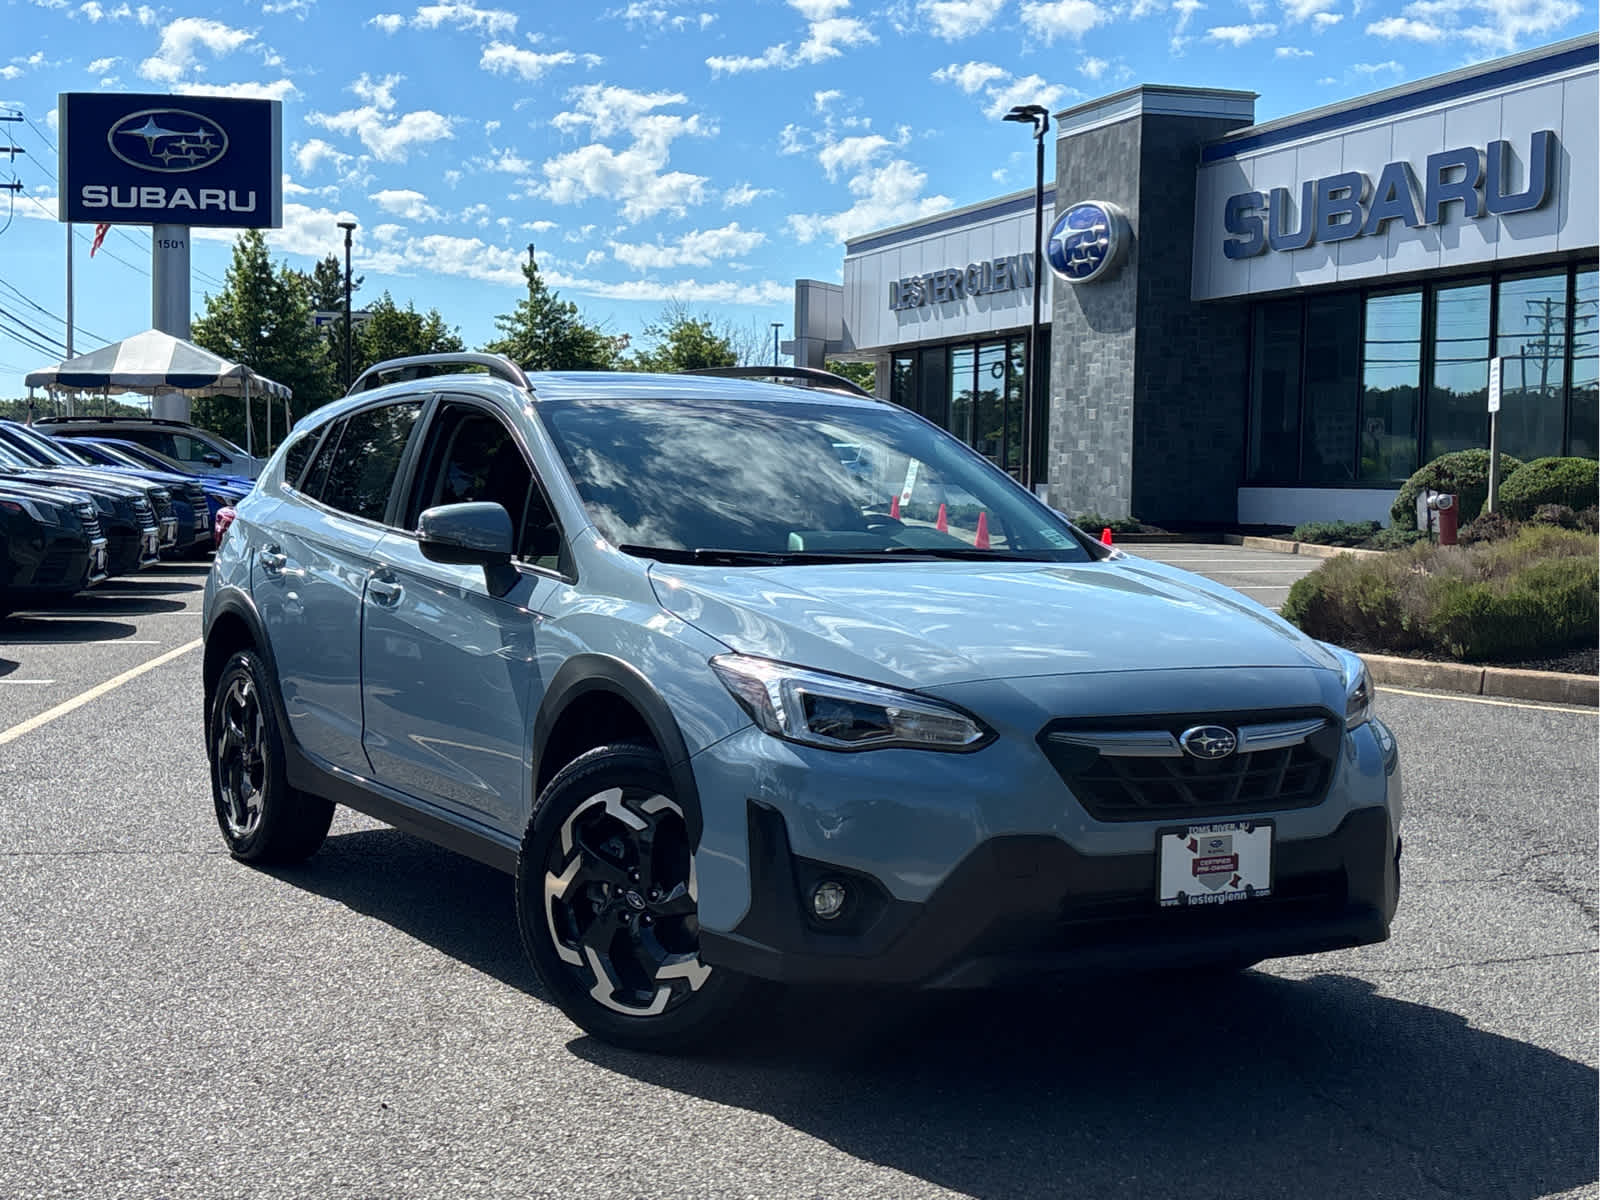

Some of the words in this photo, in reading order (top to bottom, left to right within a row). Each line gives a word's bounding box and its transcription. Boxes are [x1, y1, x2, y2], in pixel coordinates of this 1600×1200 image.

[82, 184, 256, 213] SUBARU
[1223, 130, 1554, 260] SUBARU
[157, 239, 185, 249] 1501
[889, 267, 963, 310] LESTER
[1187, 890, 1247, 905] lesterglenn
